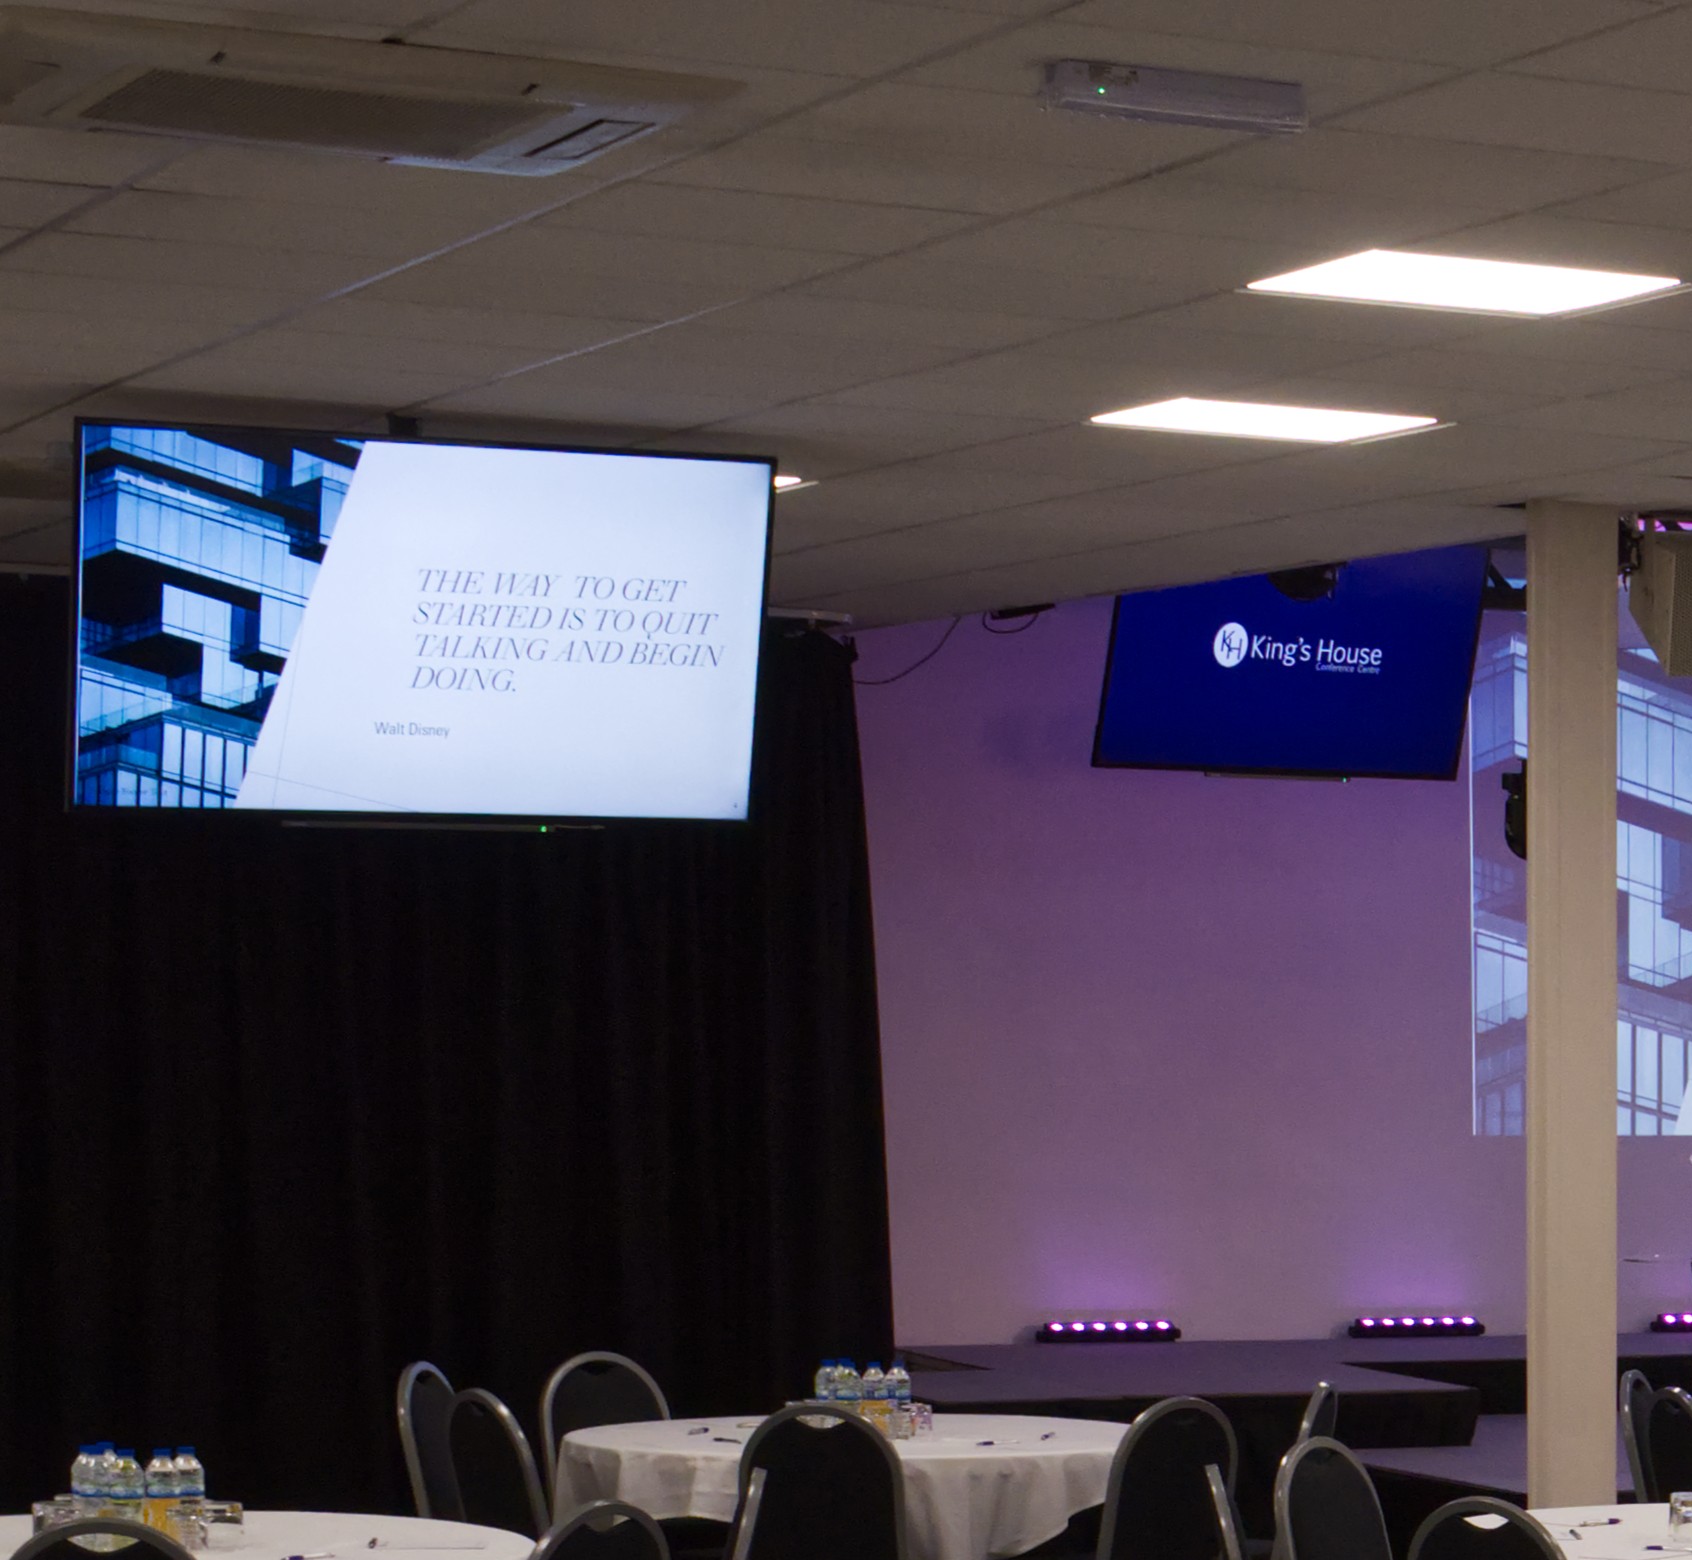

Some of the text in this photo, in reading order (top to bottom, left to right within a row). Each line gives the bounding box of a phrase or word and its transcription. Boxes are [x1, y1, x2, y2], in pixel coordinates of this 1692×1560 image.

[417, 568, 688, 603] THE WAY TO GET
[412, 601, 720, 641] STARTED IS TO QUIT
[413, 633, 726, 668] TALKING AND BEGIN
[1251, 633, 1383, 667] King's House
[408, 665, 518, 692] DOING.
[374, 721, 451, 739] Walt Disney
